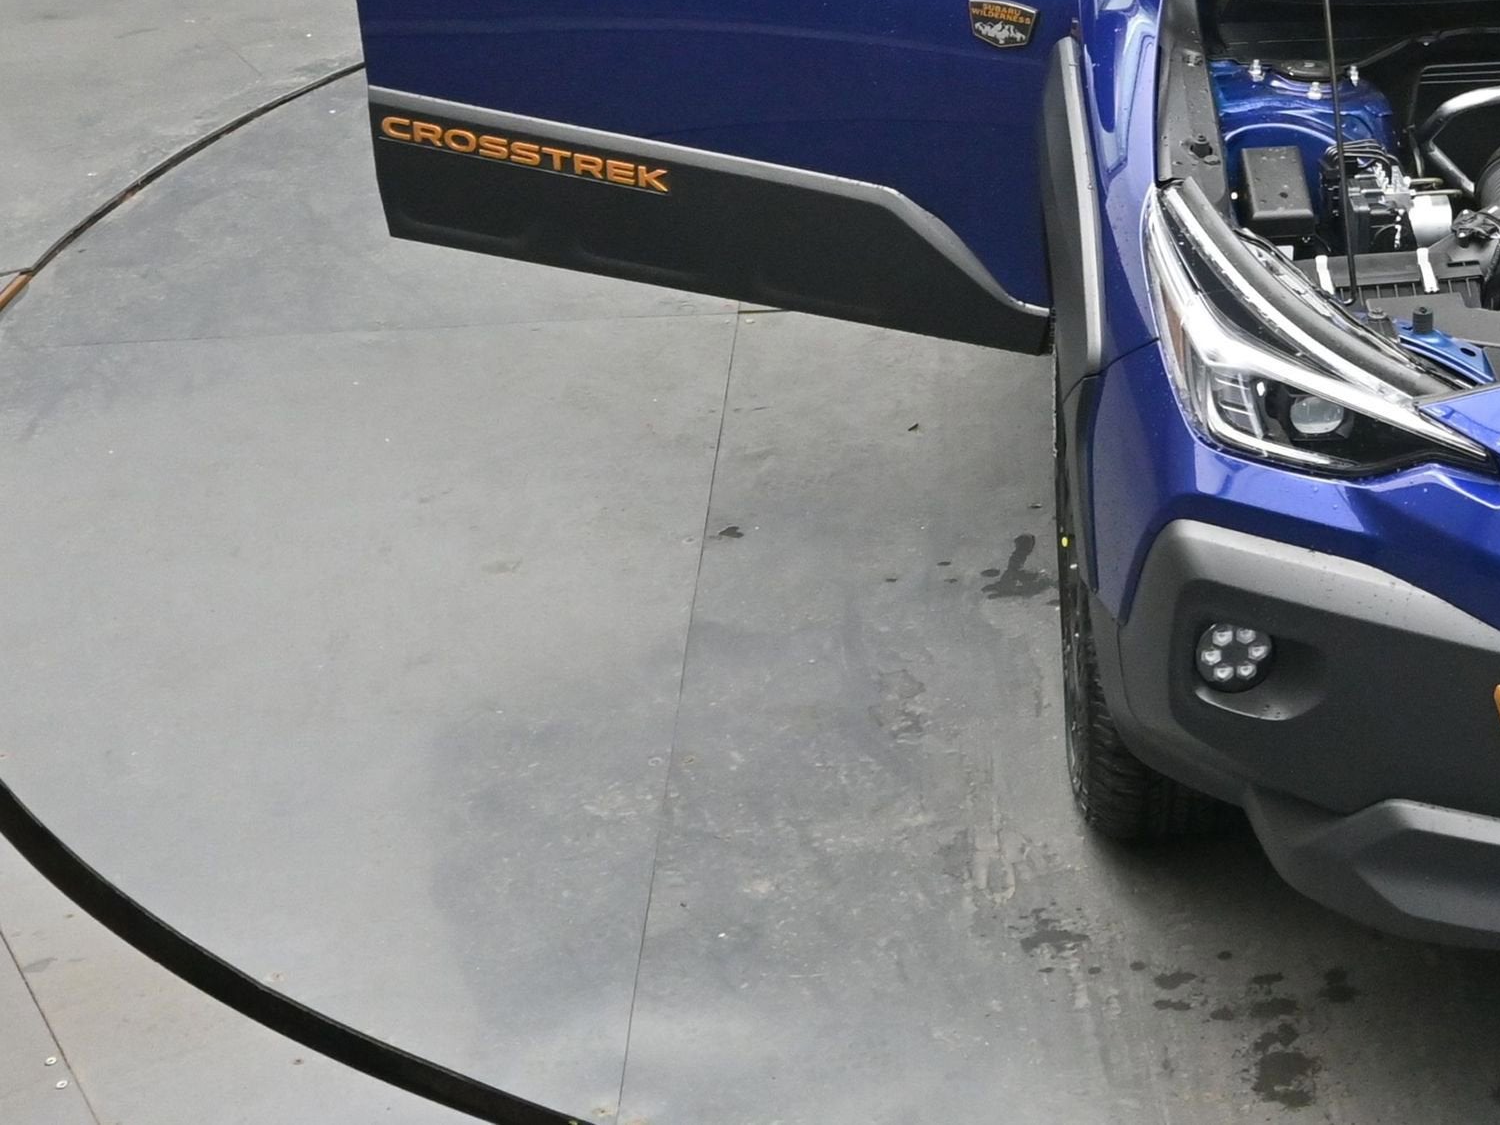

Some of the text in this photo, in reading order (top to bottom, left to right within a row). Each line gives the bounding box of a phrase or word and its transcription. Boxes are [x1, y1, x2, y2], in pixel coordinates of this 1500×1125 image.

[971, 7, 1031, 25] WILDERNESS
[982, 3, 1021, 16] SUBARU
[381, 116, 669, 193] CROSSTREK
